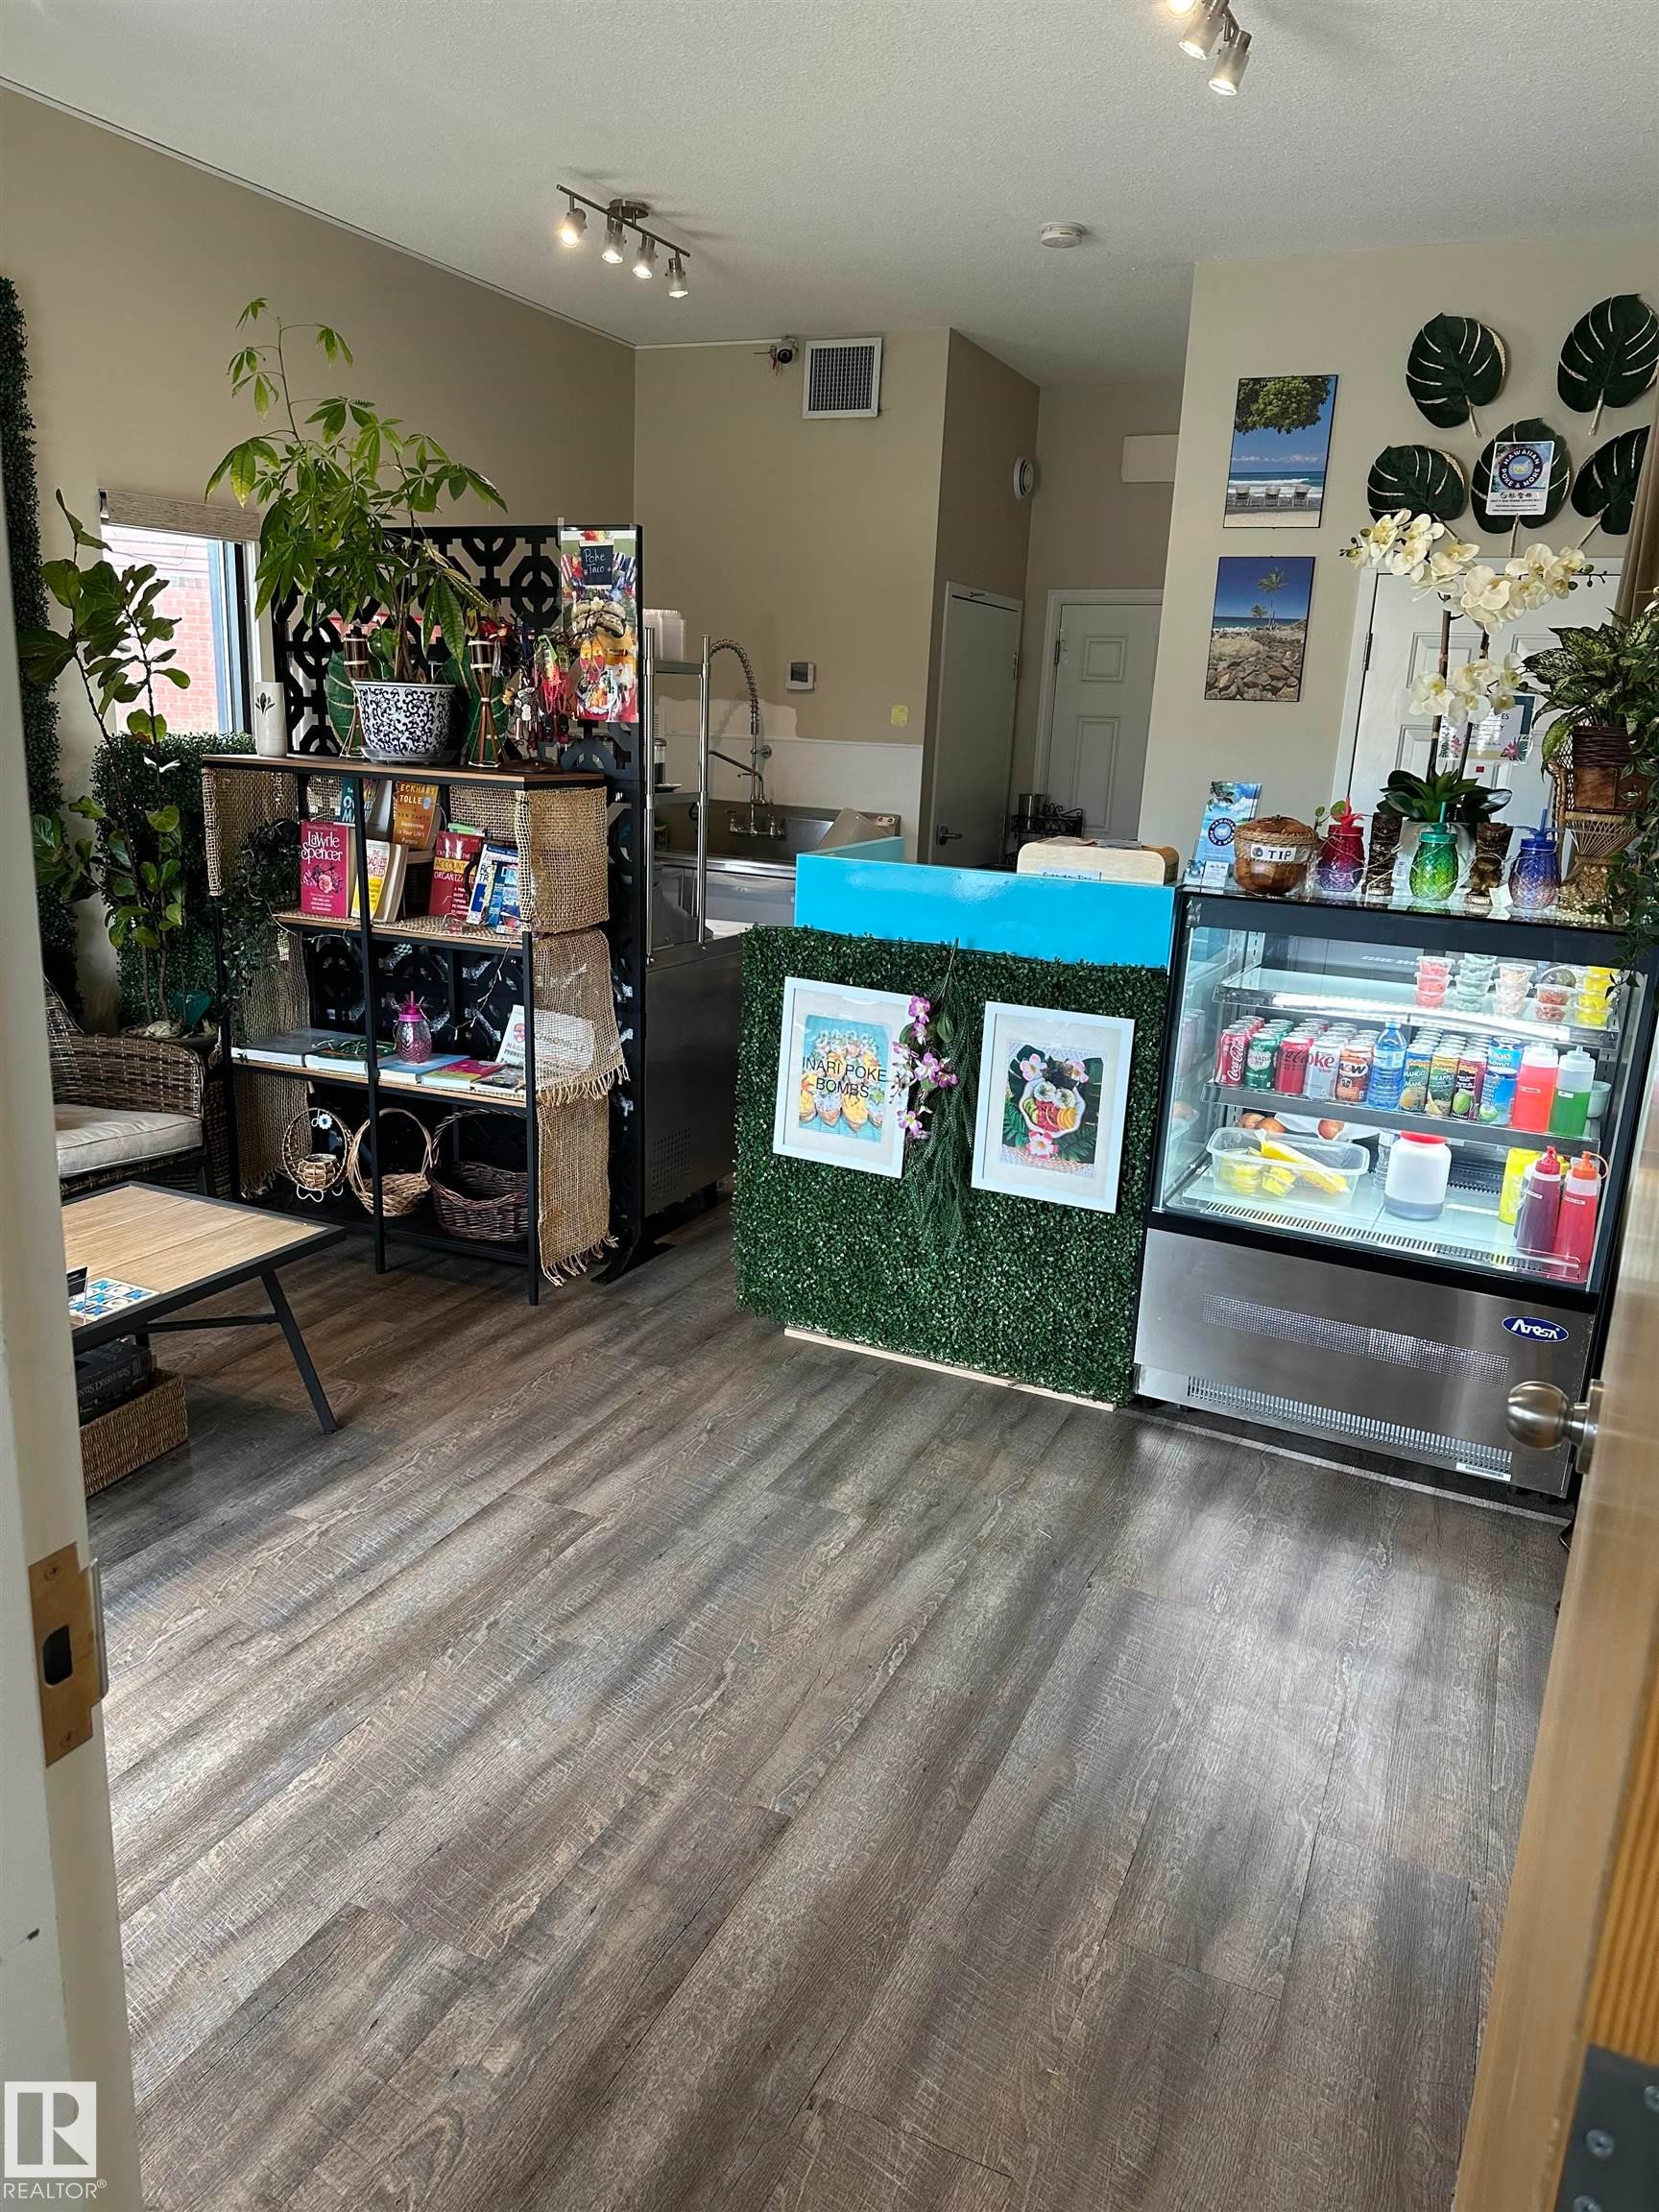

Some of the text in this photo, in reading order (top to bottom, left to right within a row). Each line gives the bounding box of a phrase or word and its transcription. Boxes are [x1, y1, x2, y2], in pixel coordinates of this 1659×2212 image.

[1503, 449, 1540, 465] HAWAIIAN
[1501, 469, 1514, 486] POKE
[1523, 468, 1541, 486] MORE
[583, 548, 606, 564] Poke
[587, 564, 605, 574] Taco
[399, 783, 437, 796] ECKHART
[399, 794, 422, 805] TOLLE
[307, 830, 341, 849] LaVyrle
[301, 841, 344, 865] Spencer
[1267, 849, 1292, 860] TIP
[802, 1056, 887, 1082] INARI POKE
[815, 1076, 870, 1098] BOMBS
